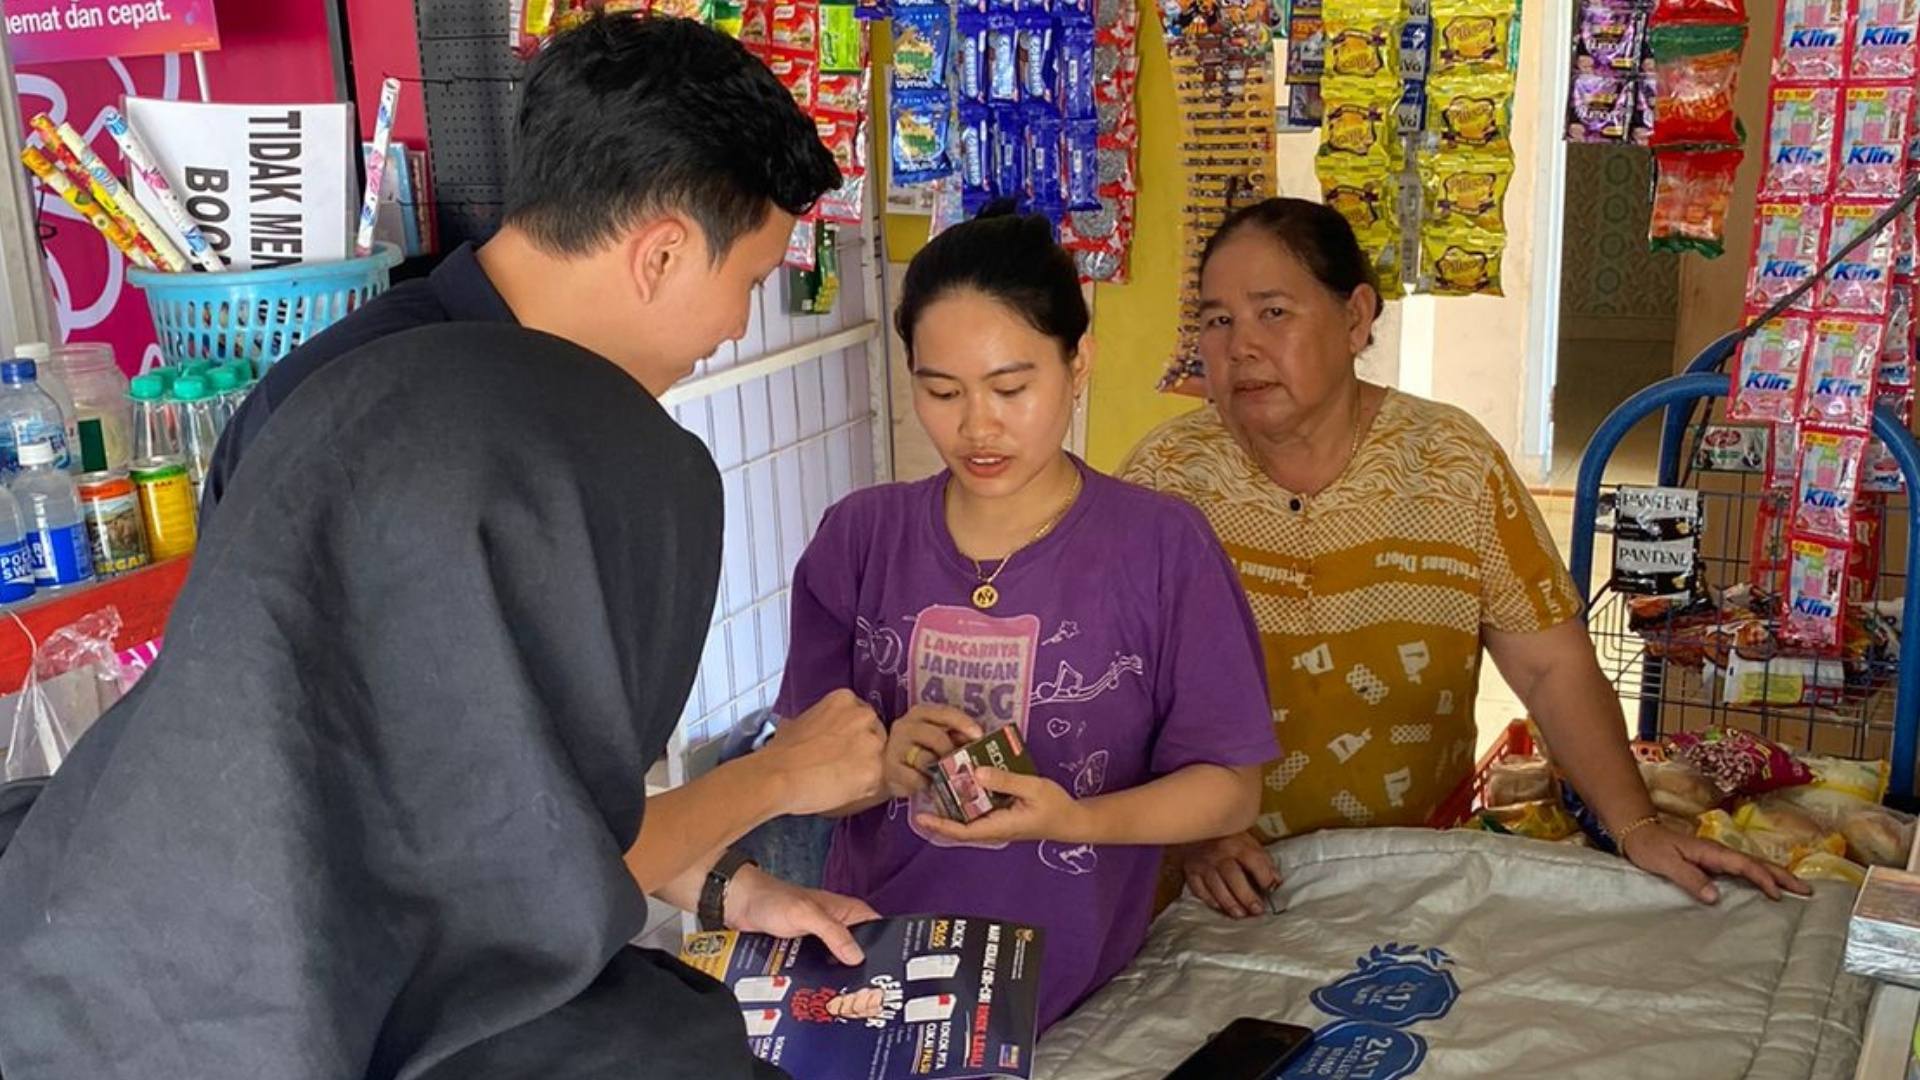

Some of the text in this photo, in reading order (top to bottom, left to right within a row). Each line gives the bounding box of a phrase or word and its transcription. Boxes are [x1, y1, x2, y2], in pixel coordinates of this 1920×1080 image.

[65, 3, 103, 29] dan
[107, 0, 171, 29] cepat.
[1790, 29, 1836, 47] Klin
[1862, 27, 1910, 45] Klin
[248, 111, 302, 203] TIDAK
[1777, 146, 1822, 163] Klin
[1848, 146, 1894, 164] Klin
[1763, 260, 1808, 277] Klin
[1833, 263, 1881, 280] Klin
[1745, 371, 1791, 390] Klin
[1816, 377, 1862, 396] Klin
[1623, 492, 1692, 511] PANTENE
[1804, 488, 1846, 507] Klin
[1620, 546, 1688, 566] PANTENE
[1794, 596, 1832, 617] Klin
[919, 652, 1020, 681] JARINGAN
[920, 676, 1015, 720] 45G
[933, 919, 949, 948] POLOS
